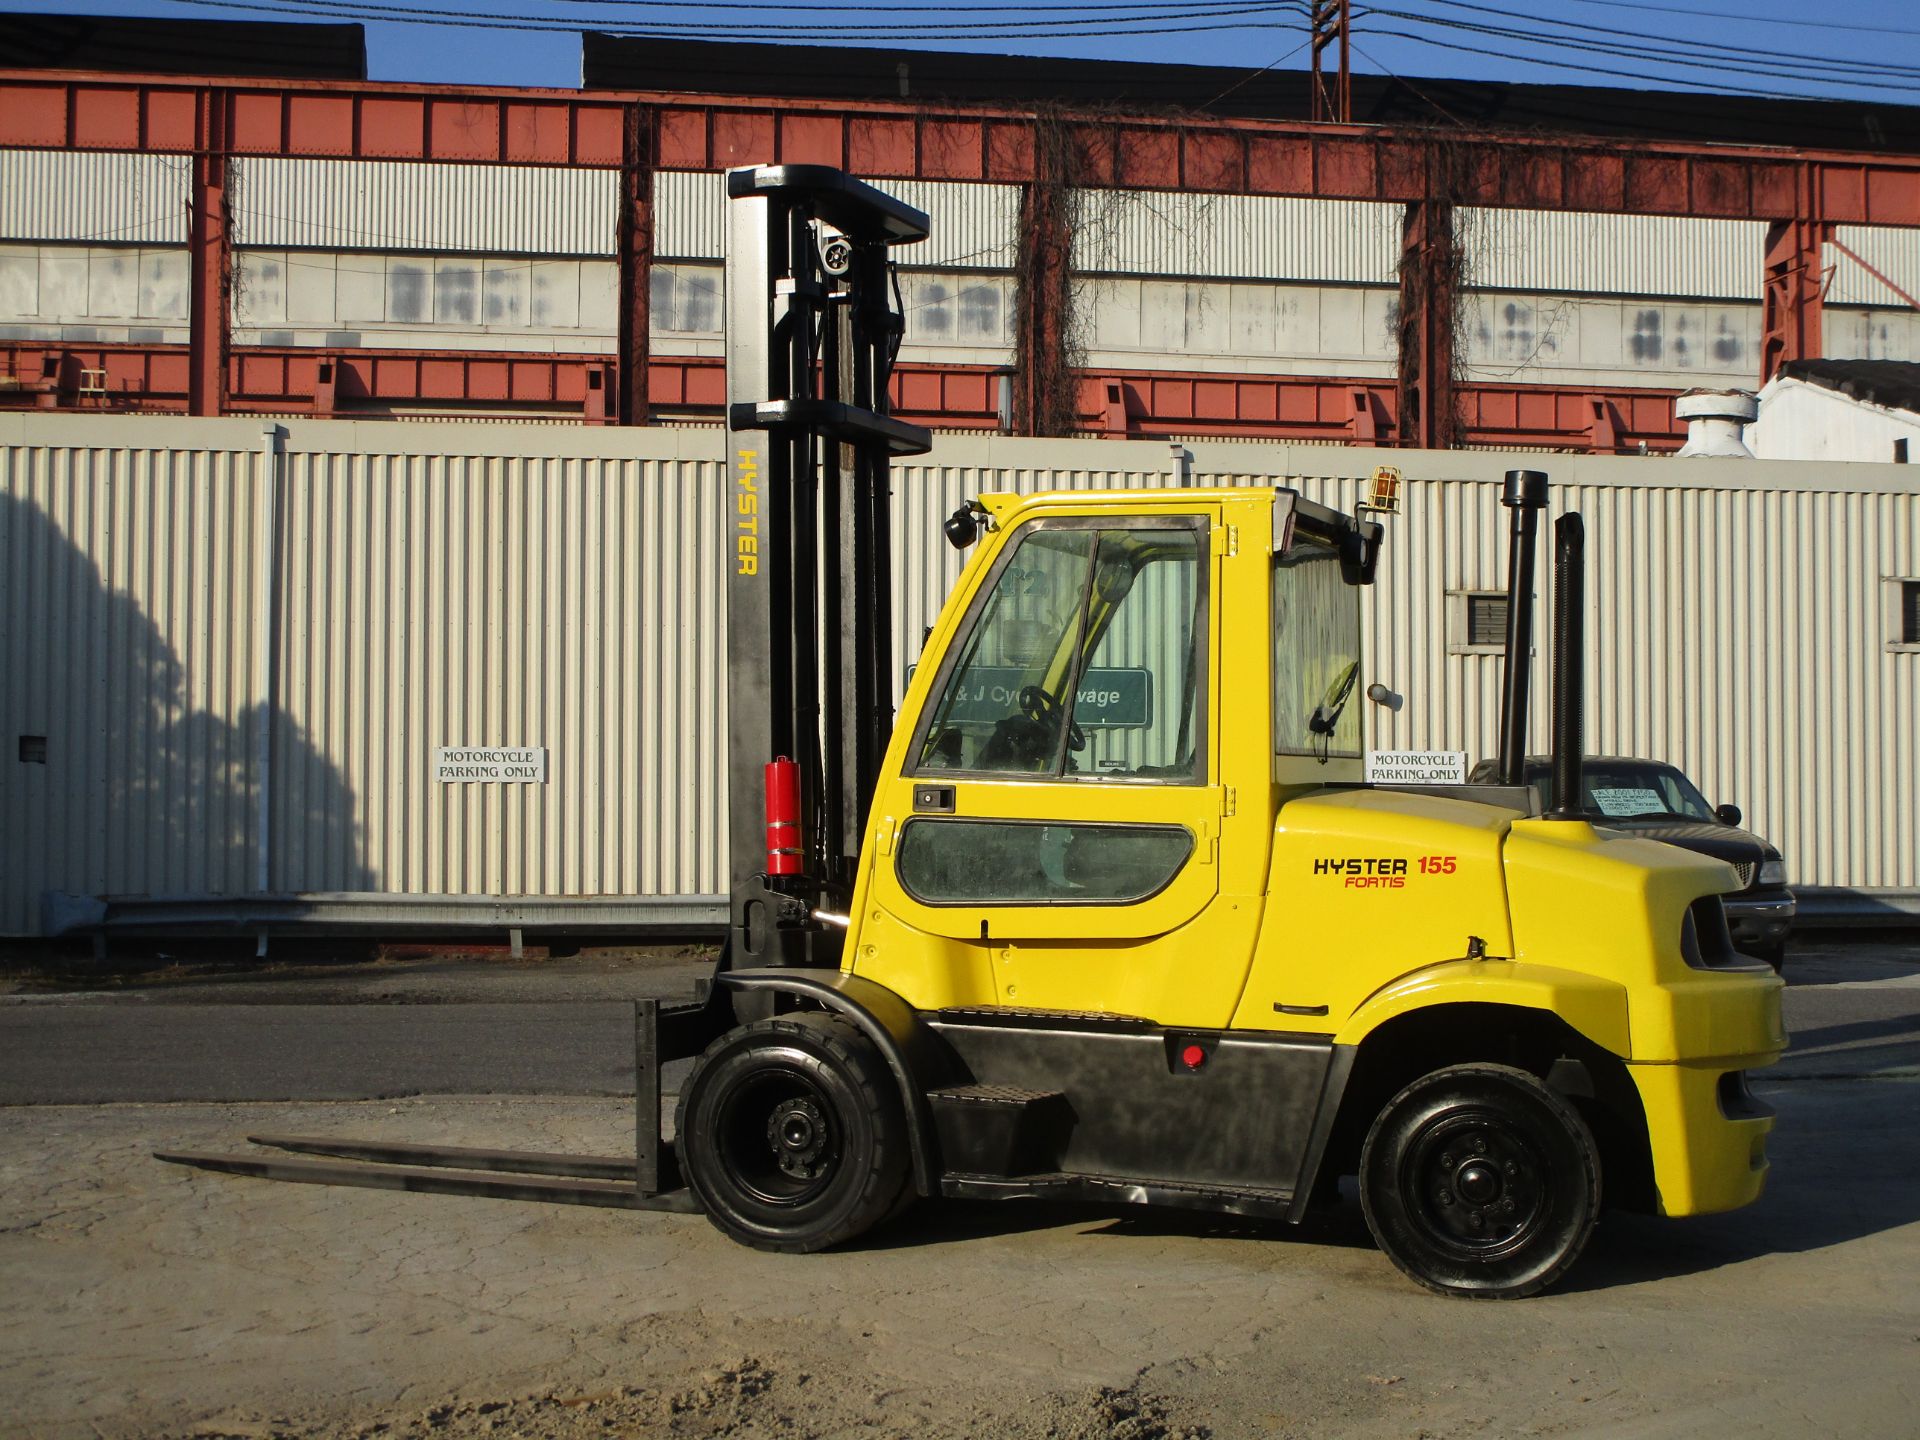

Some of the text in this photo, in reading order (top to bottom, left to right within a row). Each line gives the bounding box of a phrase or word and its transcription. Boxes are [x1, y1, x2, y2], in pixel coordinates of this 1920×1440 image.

[738, 450, 758, 575] HYSTER
[974, 685, 985, 701] J
[1077, 689, 1120, 708] vage
[444, 751, 534, 763] MOTORCYCLE
[1375, 755, 1456, 766] MOTORCYCLE
[439, 766, 538, 778] PARKING ONLY
[1371, 769, 1460, 780] PARKING ONLY
[1313, 856, 1457, 875] HYSTER 155
[1344, 876, 1405, 888] FORTIS
